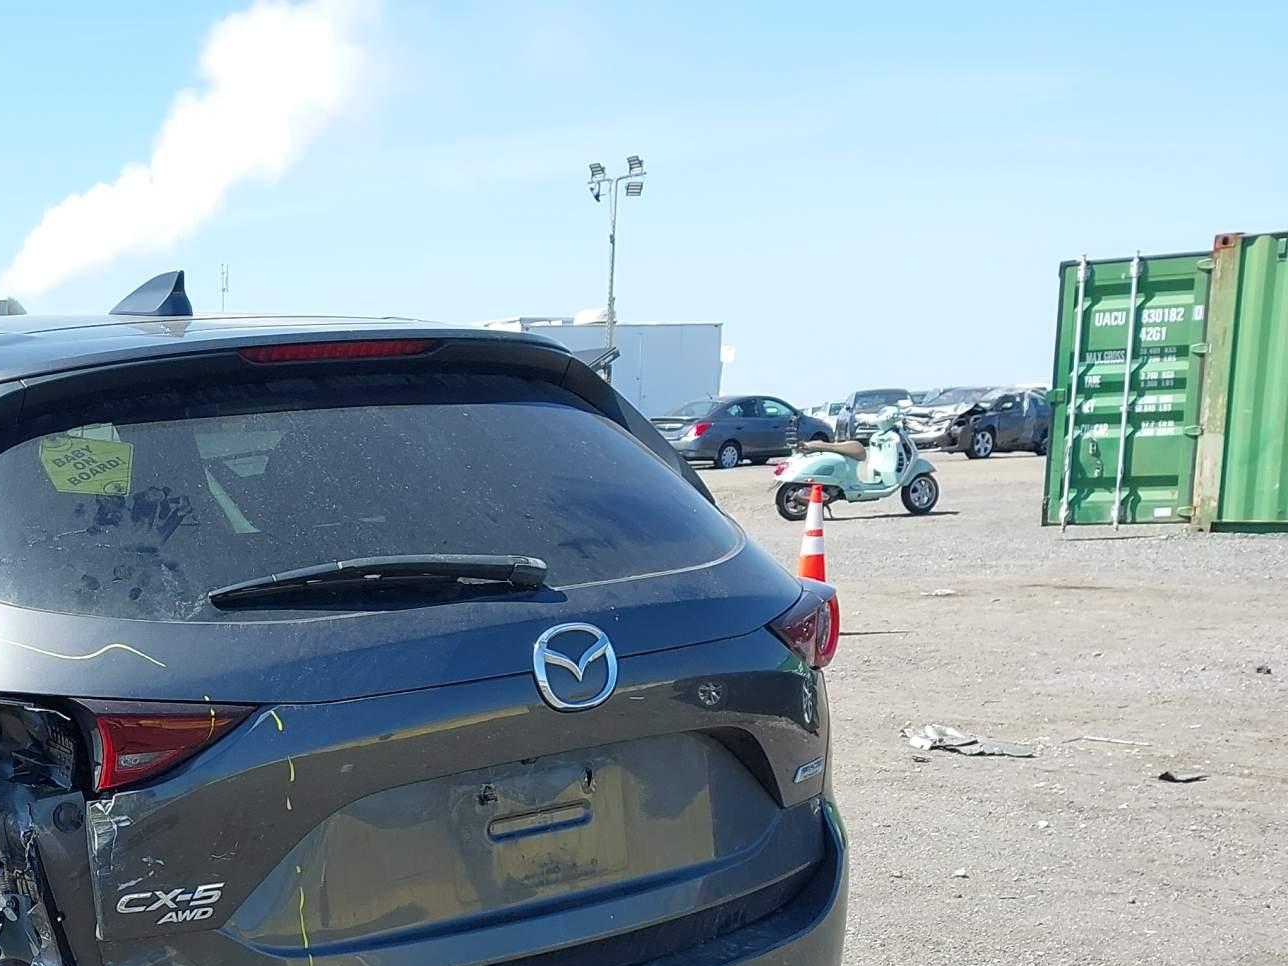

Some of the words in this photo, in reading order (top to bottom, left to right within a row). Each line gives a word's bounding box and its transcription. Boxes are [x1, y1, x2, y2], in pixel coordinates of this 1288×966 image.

[1095, 311, 1126, 326] UACU
[1141, 307, 1185, 324] 830182
[1139, 326, 1167, 341] 42G1
[52, 445, 93, 468] BABY
[73, 456, 97, 471] ON
[67, 456, 127, 487] BOARD!
[116, 881, 225, 914] CX-5
[156, 907, 214, 925] AWD
